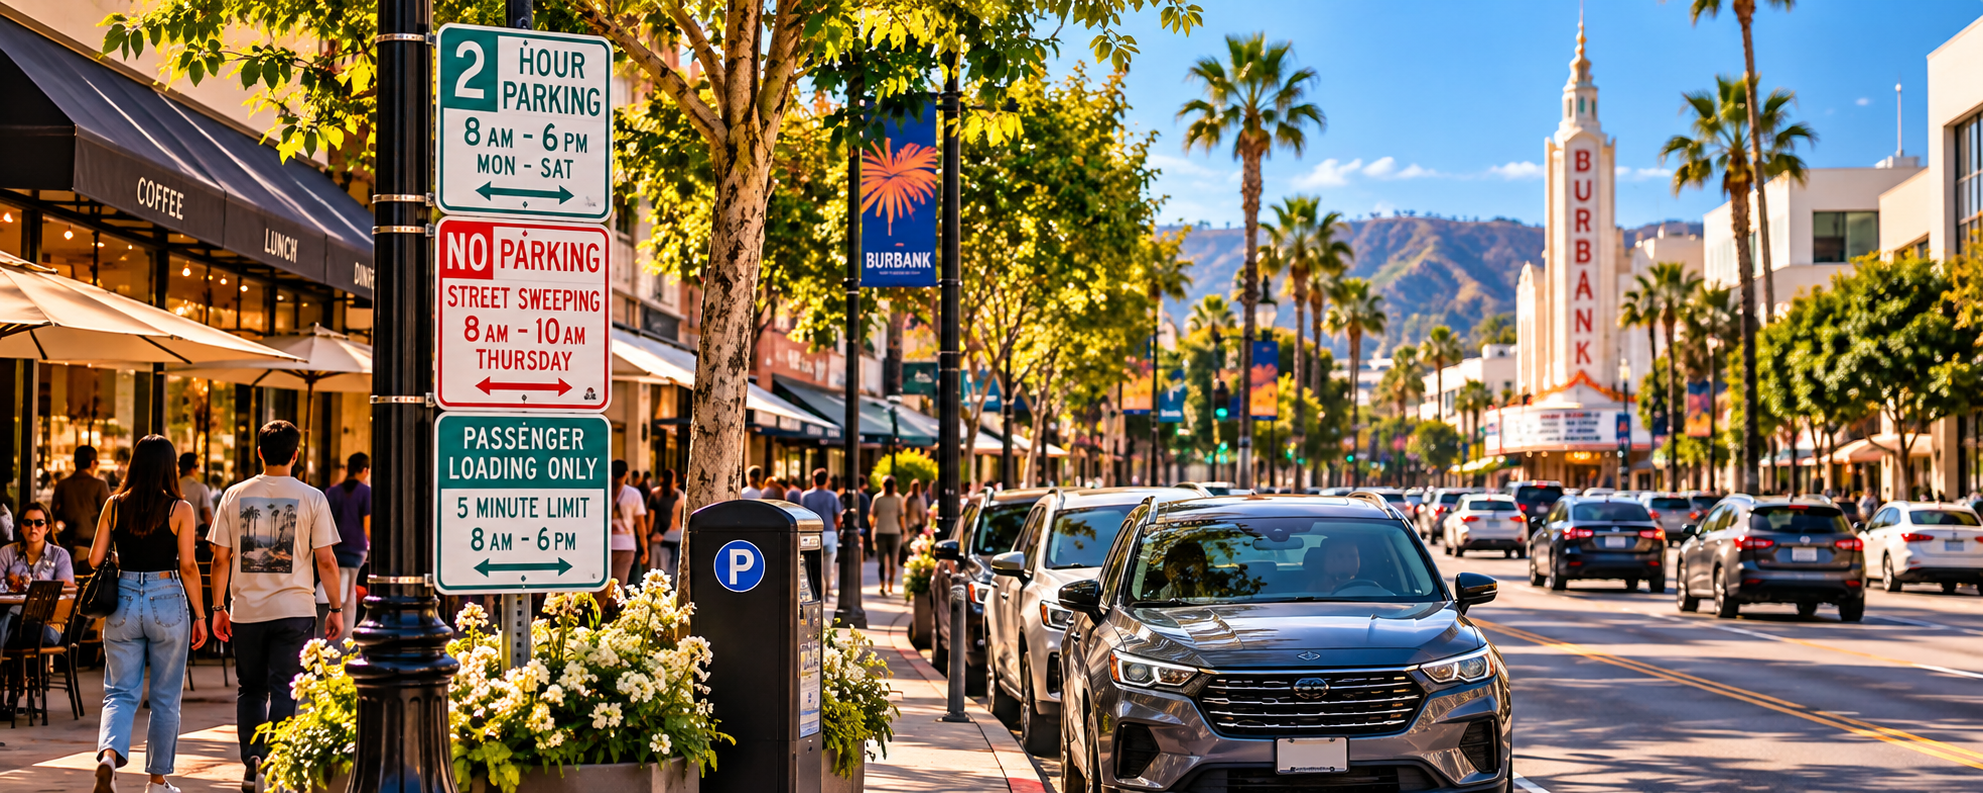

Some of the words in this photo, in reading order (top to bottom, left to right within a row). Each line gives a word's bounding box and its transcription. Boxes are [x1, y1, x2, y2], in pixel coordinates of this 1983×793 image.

[454, 40, 485, 99] 2
[520, 48, 585, 79] HOUR
[504, 81, 600, 116] PARKING
[465, 117, 480, 146] 8
[488, 128, 512, 148] AM
[543, 123, 557, 151] 6
[565, 133, 587, 153] PM
[478, 154, 515, 175] MON
[541, 158, 573, 179] SAT
[137, 176, 184, 220] COFFEE
[264, 228, 298, 264] LUNCH
[447, 232, 487, 271] NO
[501, 239, 599, 272] PARKING
[867, 252, 931, 268] BURBANK
[1574, 149, 1593, 366] BURBANK
[448, 285, 510, 308] STREET
[519, 288, 599, 312] SWEEPING
[464, 316, 479, 342] 8
[485, 324, 508, 342] AM
[536, 318, 559, 344] 10
[564, 326, 585, 344] AM
[476, 349, 572, 371] THURSDAY
[464, 426, 584, 450] PASSENGER
[450, 457, 536, 479] LOADING
[548, 457, 597, 479] ONLY
[457, 497, 469, 519] 5
[477, 497, 538, 518] MINUTE
[548, 498, 589, 518] LIMIT
[471, 528, 484, 551] 8
[490, 533, 512, 550] AM
[538, 527, 549, 550] 6
[555, 533, 575, 550] PM
[728, 548, 755, 585] P
